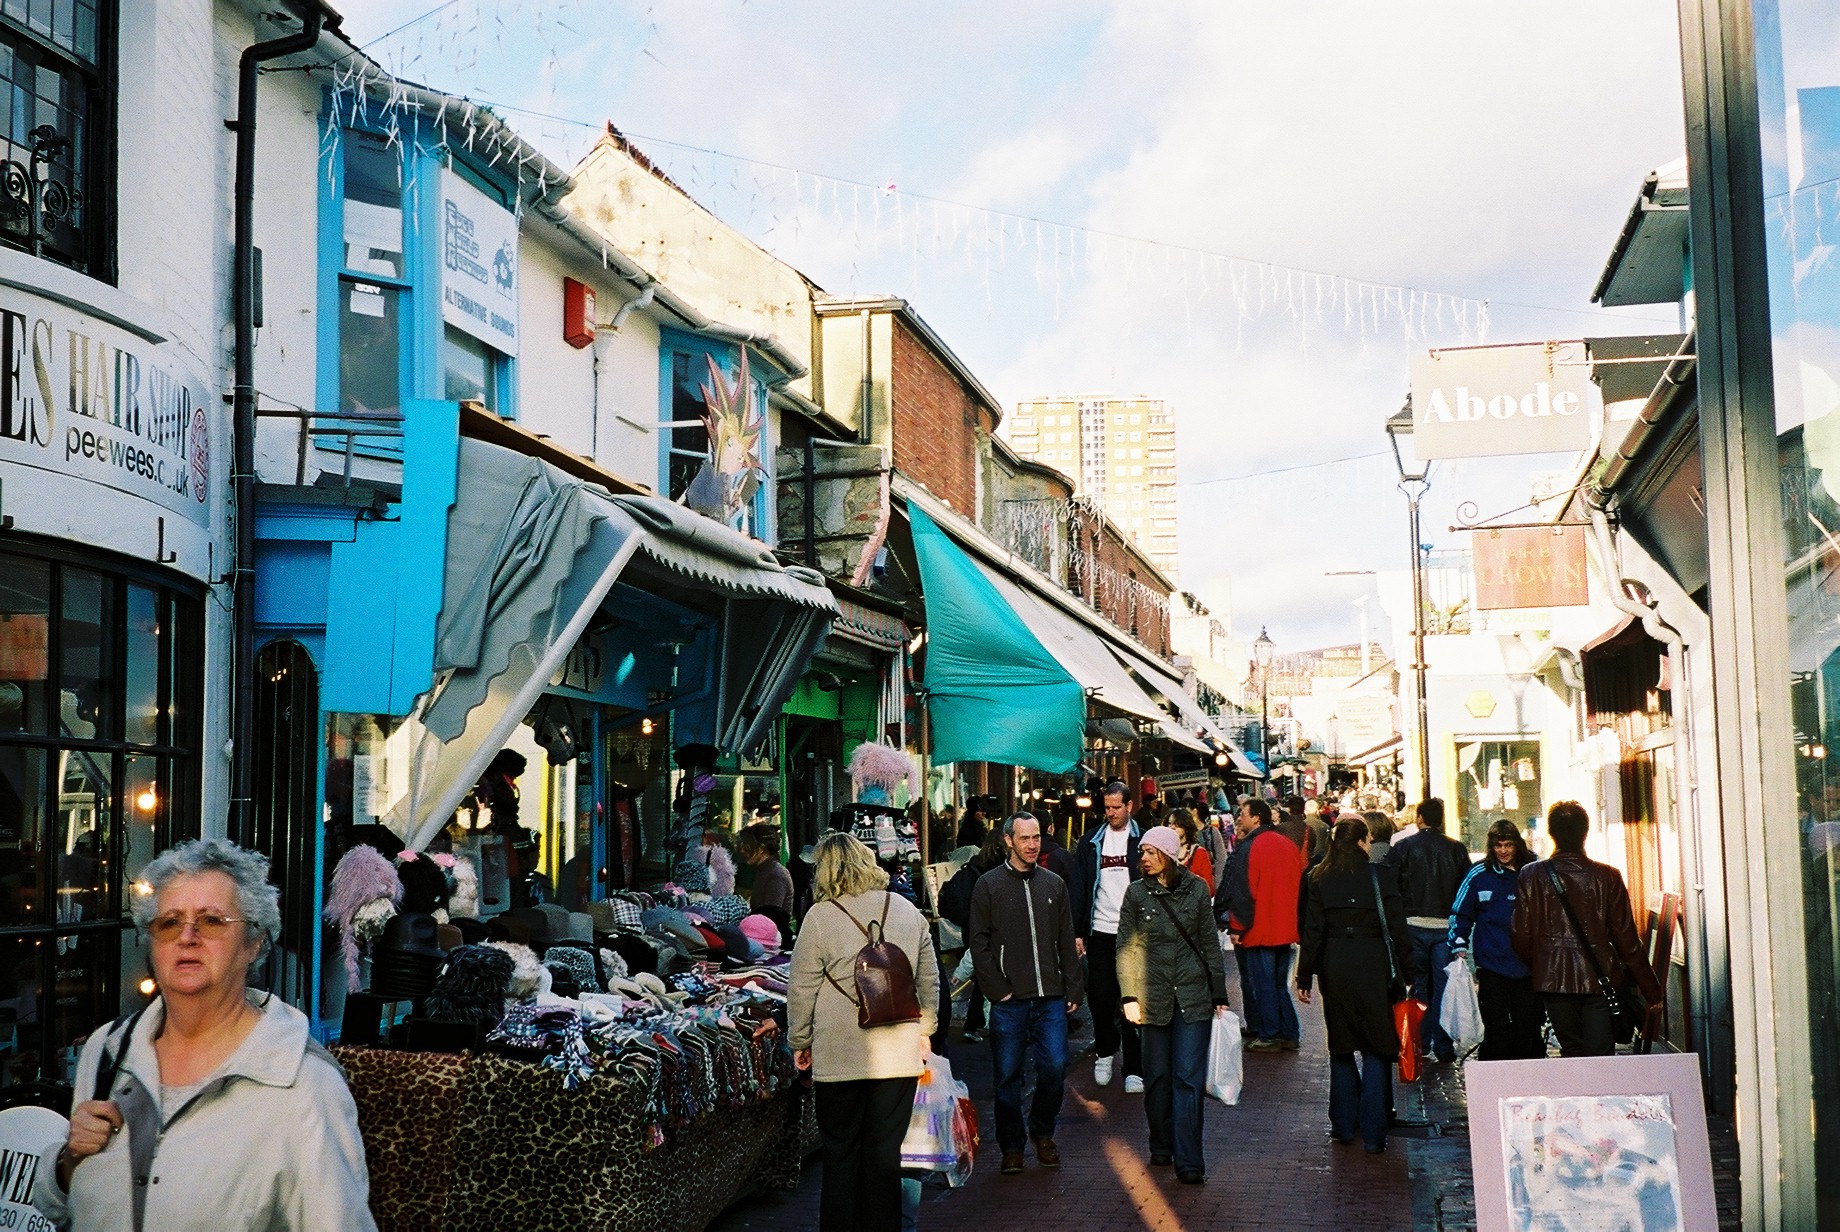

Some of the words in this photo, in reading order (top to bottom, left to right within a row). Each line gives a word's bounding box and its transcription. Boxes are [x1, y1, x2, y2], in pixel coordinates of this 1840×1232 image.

[444, 285, 488, 325] ALTERNATIVE
[490, 311, 515, 339] SOUNDS
[66, 329, 142, 437] HAIR
[147, 364, 191, 461] SHOP
[1422, 381, 1580, 424] Abode
[66, 425, 189, 498] peewees.c.uk
[1480, 562, 1584, 586] CROWN
[1158, 773, 1183, 783] GALLERY
